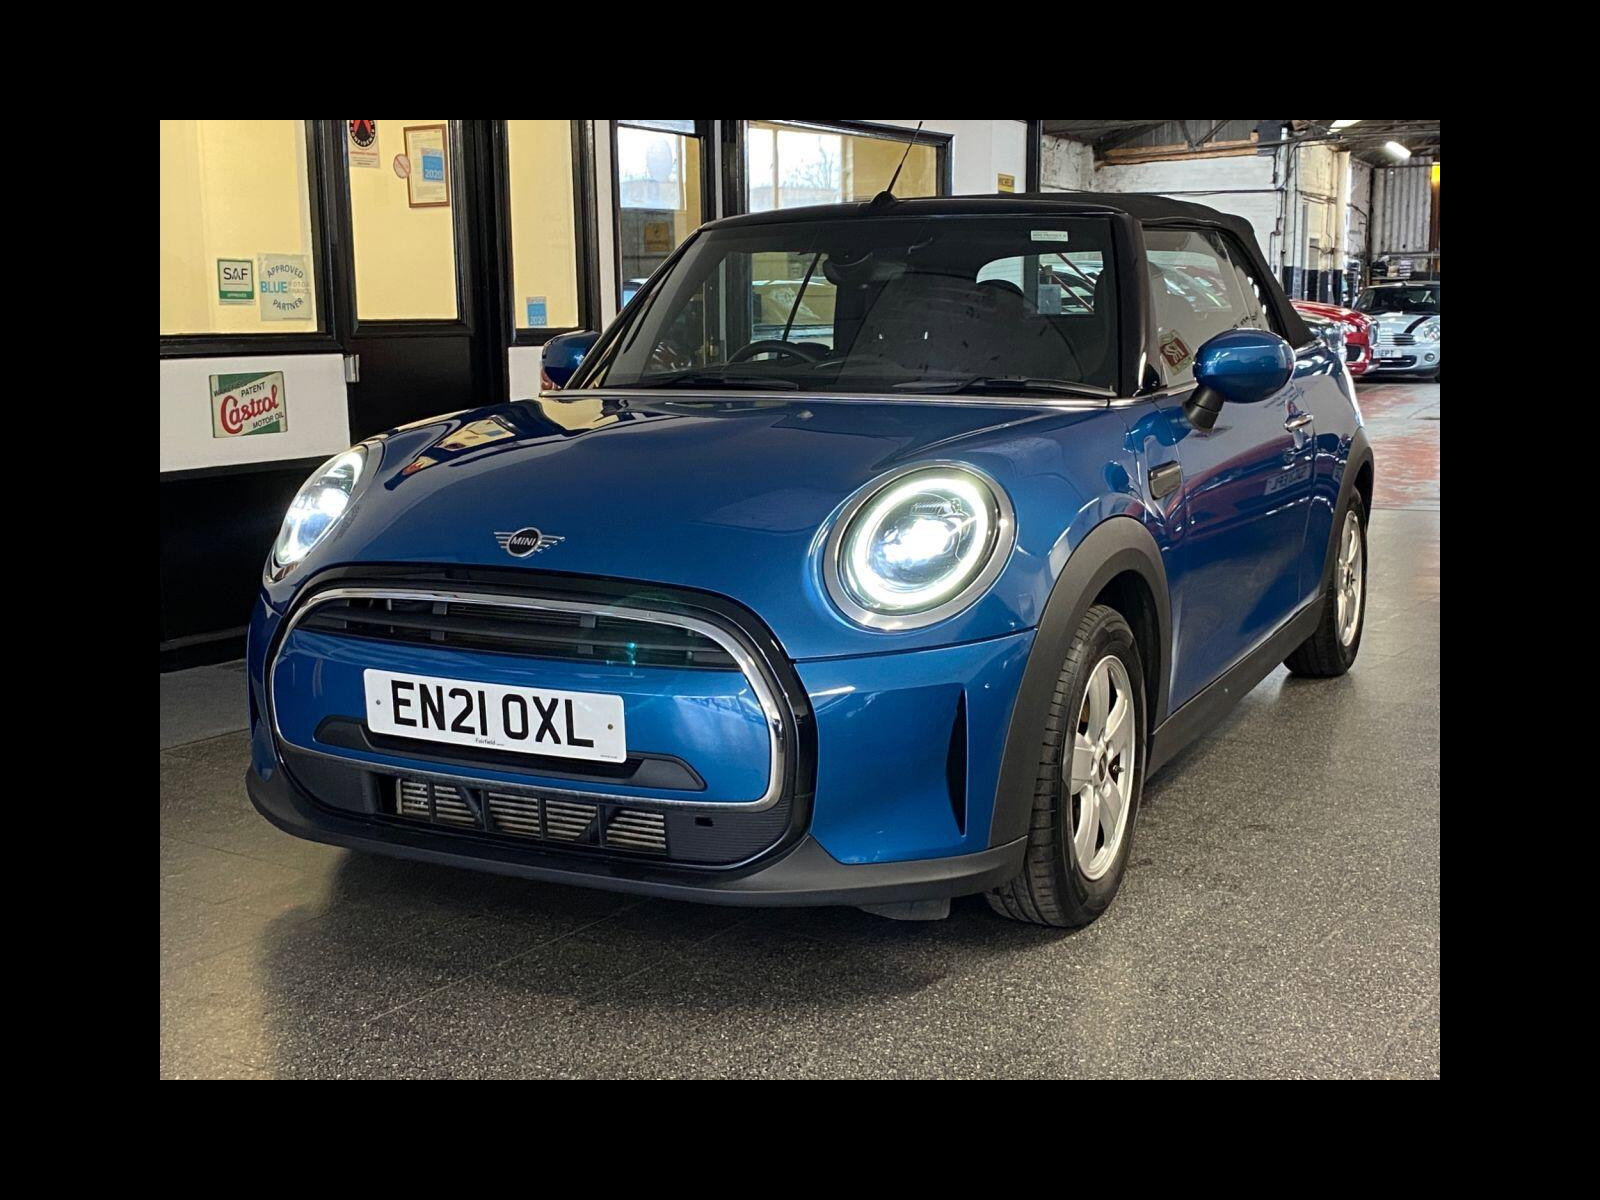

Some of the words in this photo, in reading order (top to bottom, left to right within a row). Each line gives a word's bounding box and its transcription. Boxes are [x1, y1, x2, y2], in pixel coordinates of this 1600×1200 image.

[223, 267, 248, 280] SAF
[267, 264, 304, 279] APPROVED
[260, 281, 287, 293] BLUE
[273, 297, 304, 311] PARTNER
[240, 381, 266, 397] PATENT
[220, 384, 279, 434] Castrol
[252, 416, 274, 429] MOTOR
[274, 411, 284, 420] OIL
[511, 536, 537, 546] MINI
[391, 679, 488, 736] EN21
[501, 693, 594, 748] OXL
